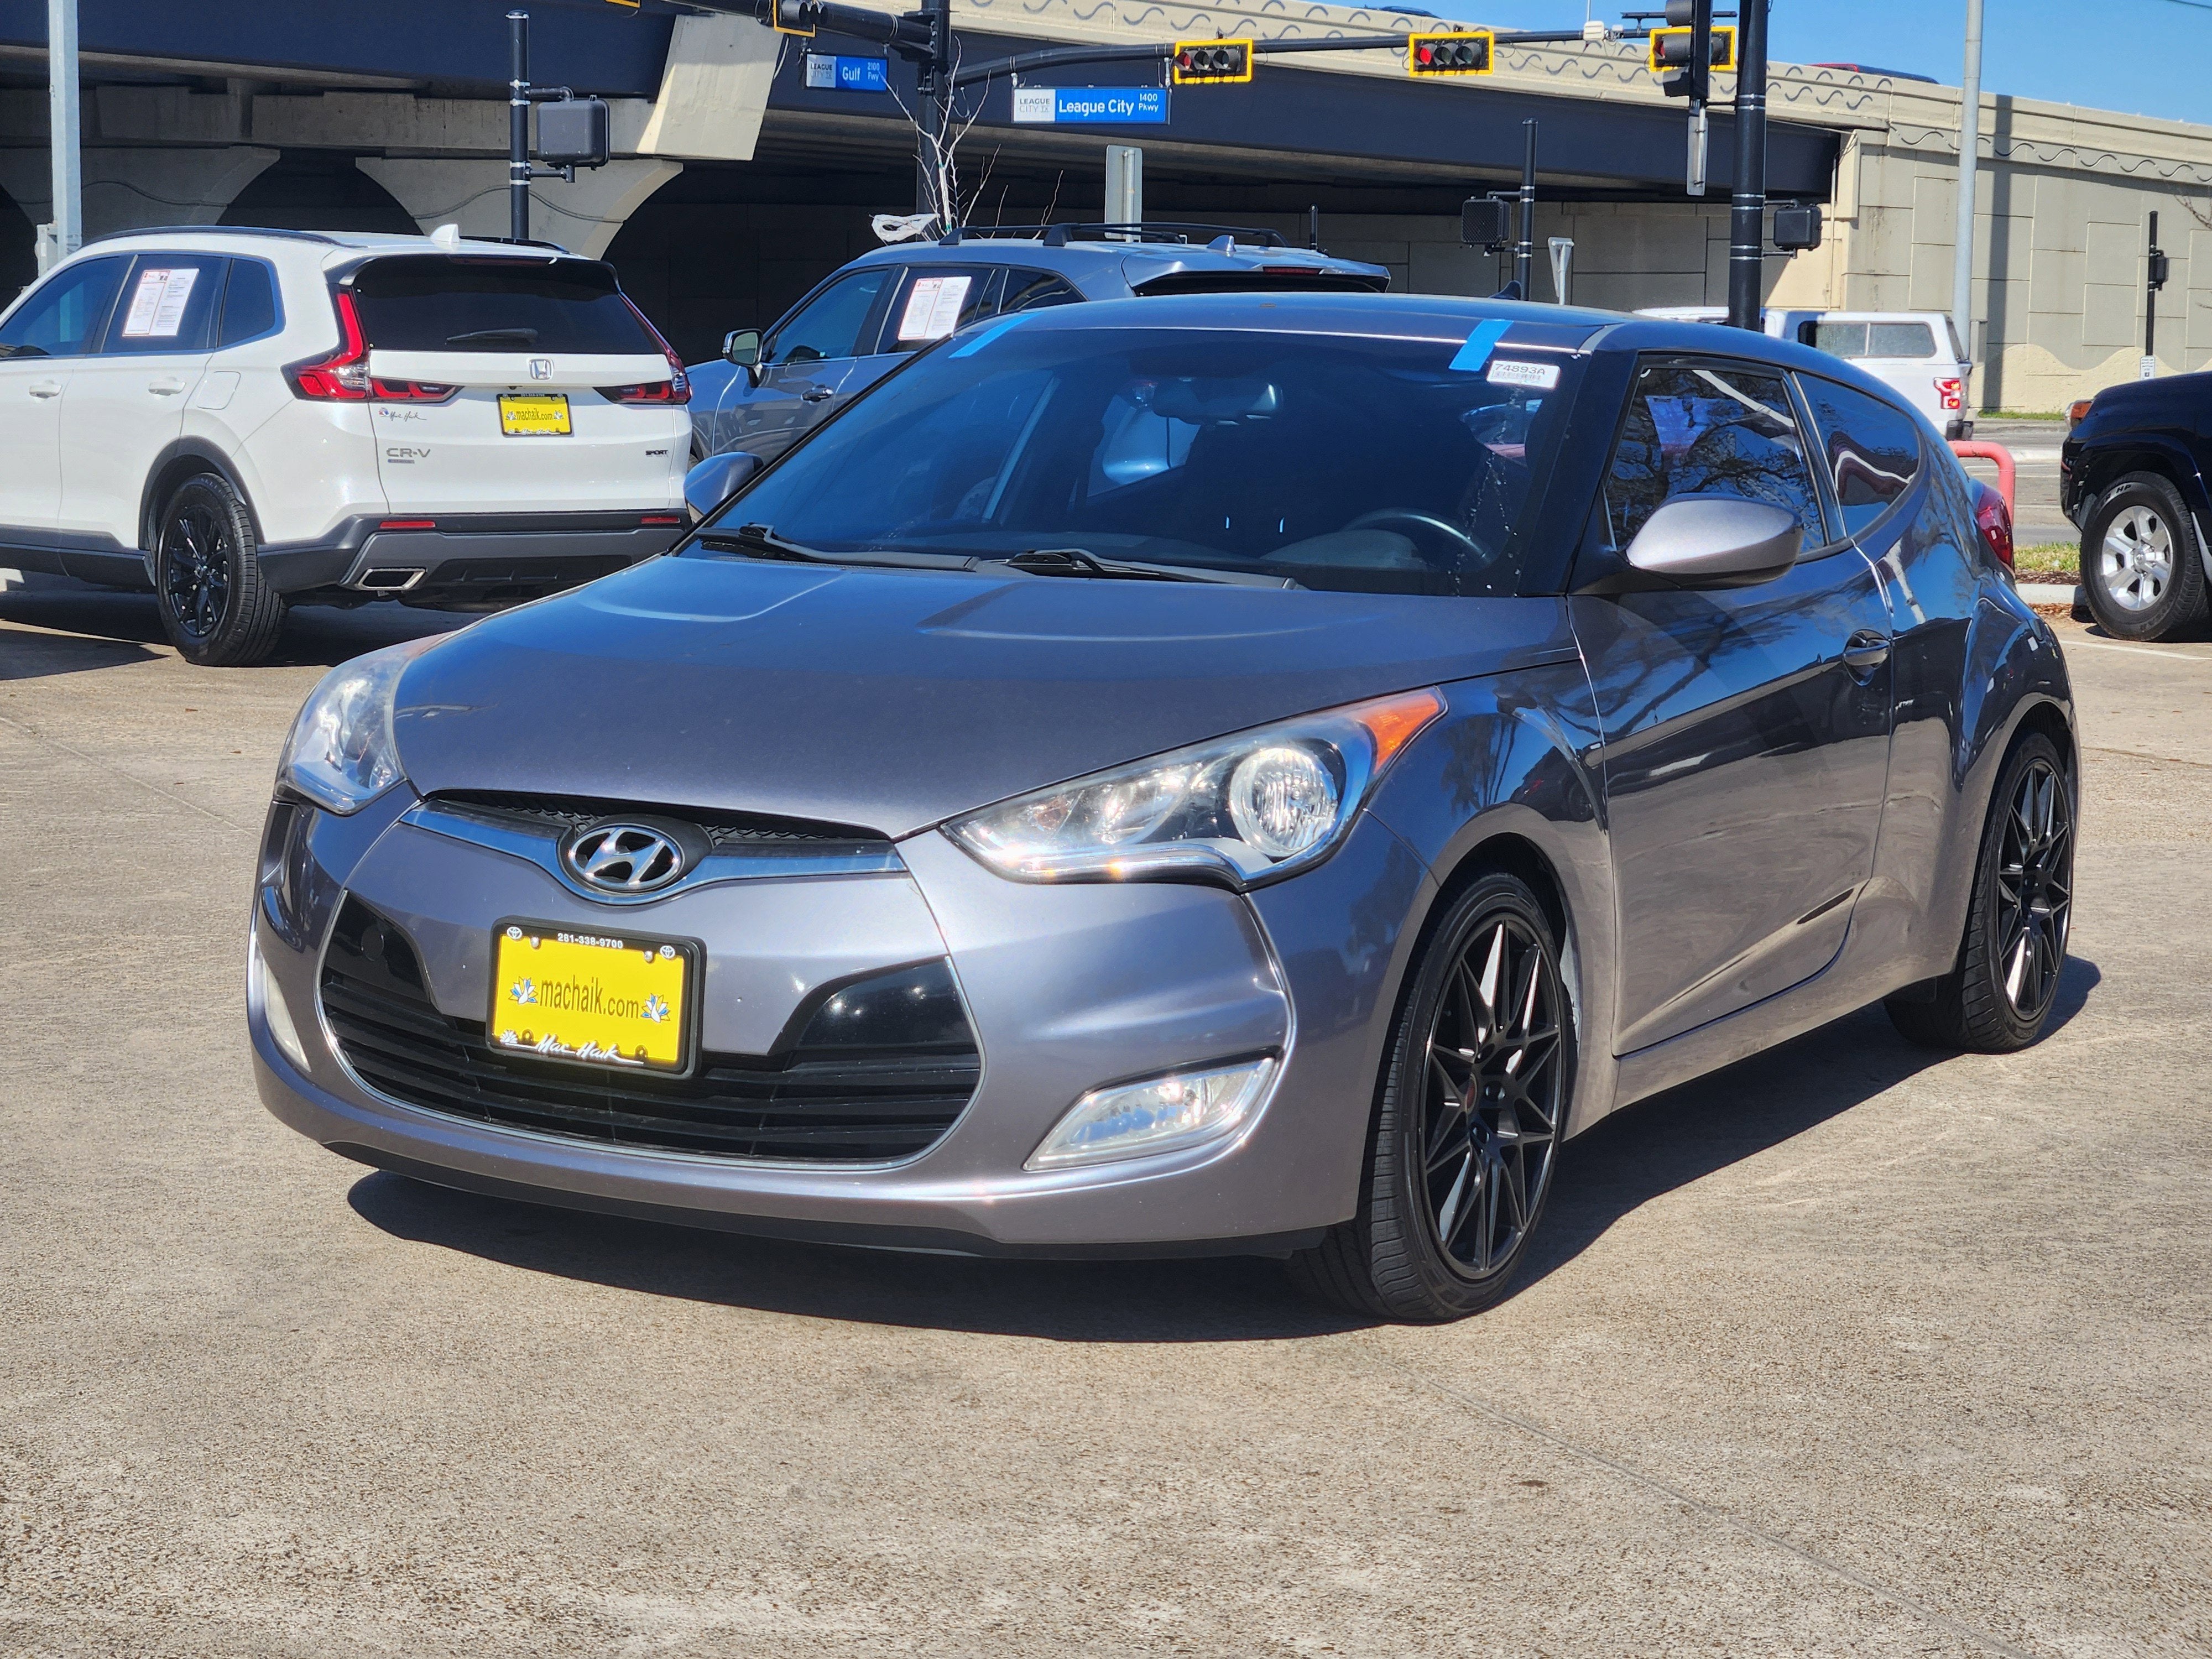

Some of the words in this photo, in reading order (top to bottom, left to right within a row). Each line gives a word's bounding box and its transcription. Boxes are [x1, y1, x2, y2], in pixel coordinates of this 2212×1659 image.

[867, 62, 880, 71] 2100
[842, 66, 860, 81] Gulf
[868, 71, 879, 82] Fwy
[1139, 93, 1157, 102] 1400
[1059, 100, 1105, 117] League
[1108, 99, 1134, 116] City
[1138, 103, 1159, 113] Pkwy
[1495, 363, 1545, 375] 74893A
[516, 408, 553, 421] machaik.com
[386, 447, 431, 458] CR-V
[557, 932, 623, 950] 281-338-9700
[540, 974, 639, 1019] machaik.com
[535, 1033, 575, 1055] Mac
[576, 1039, 644, 1066] Haik
